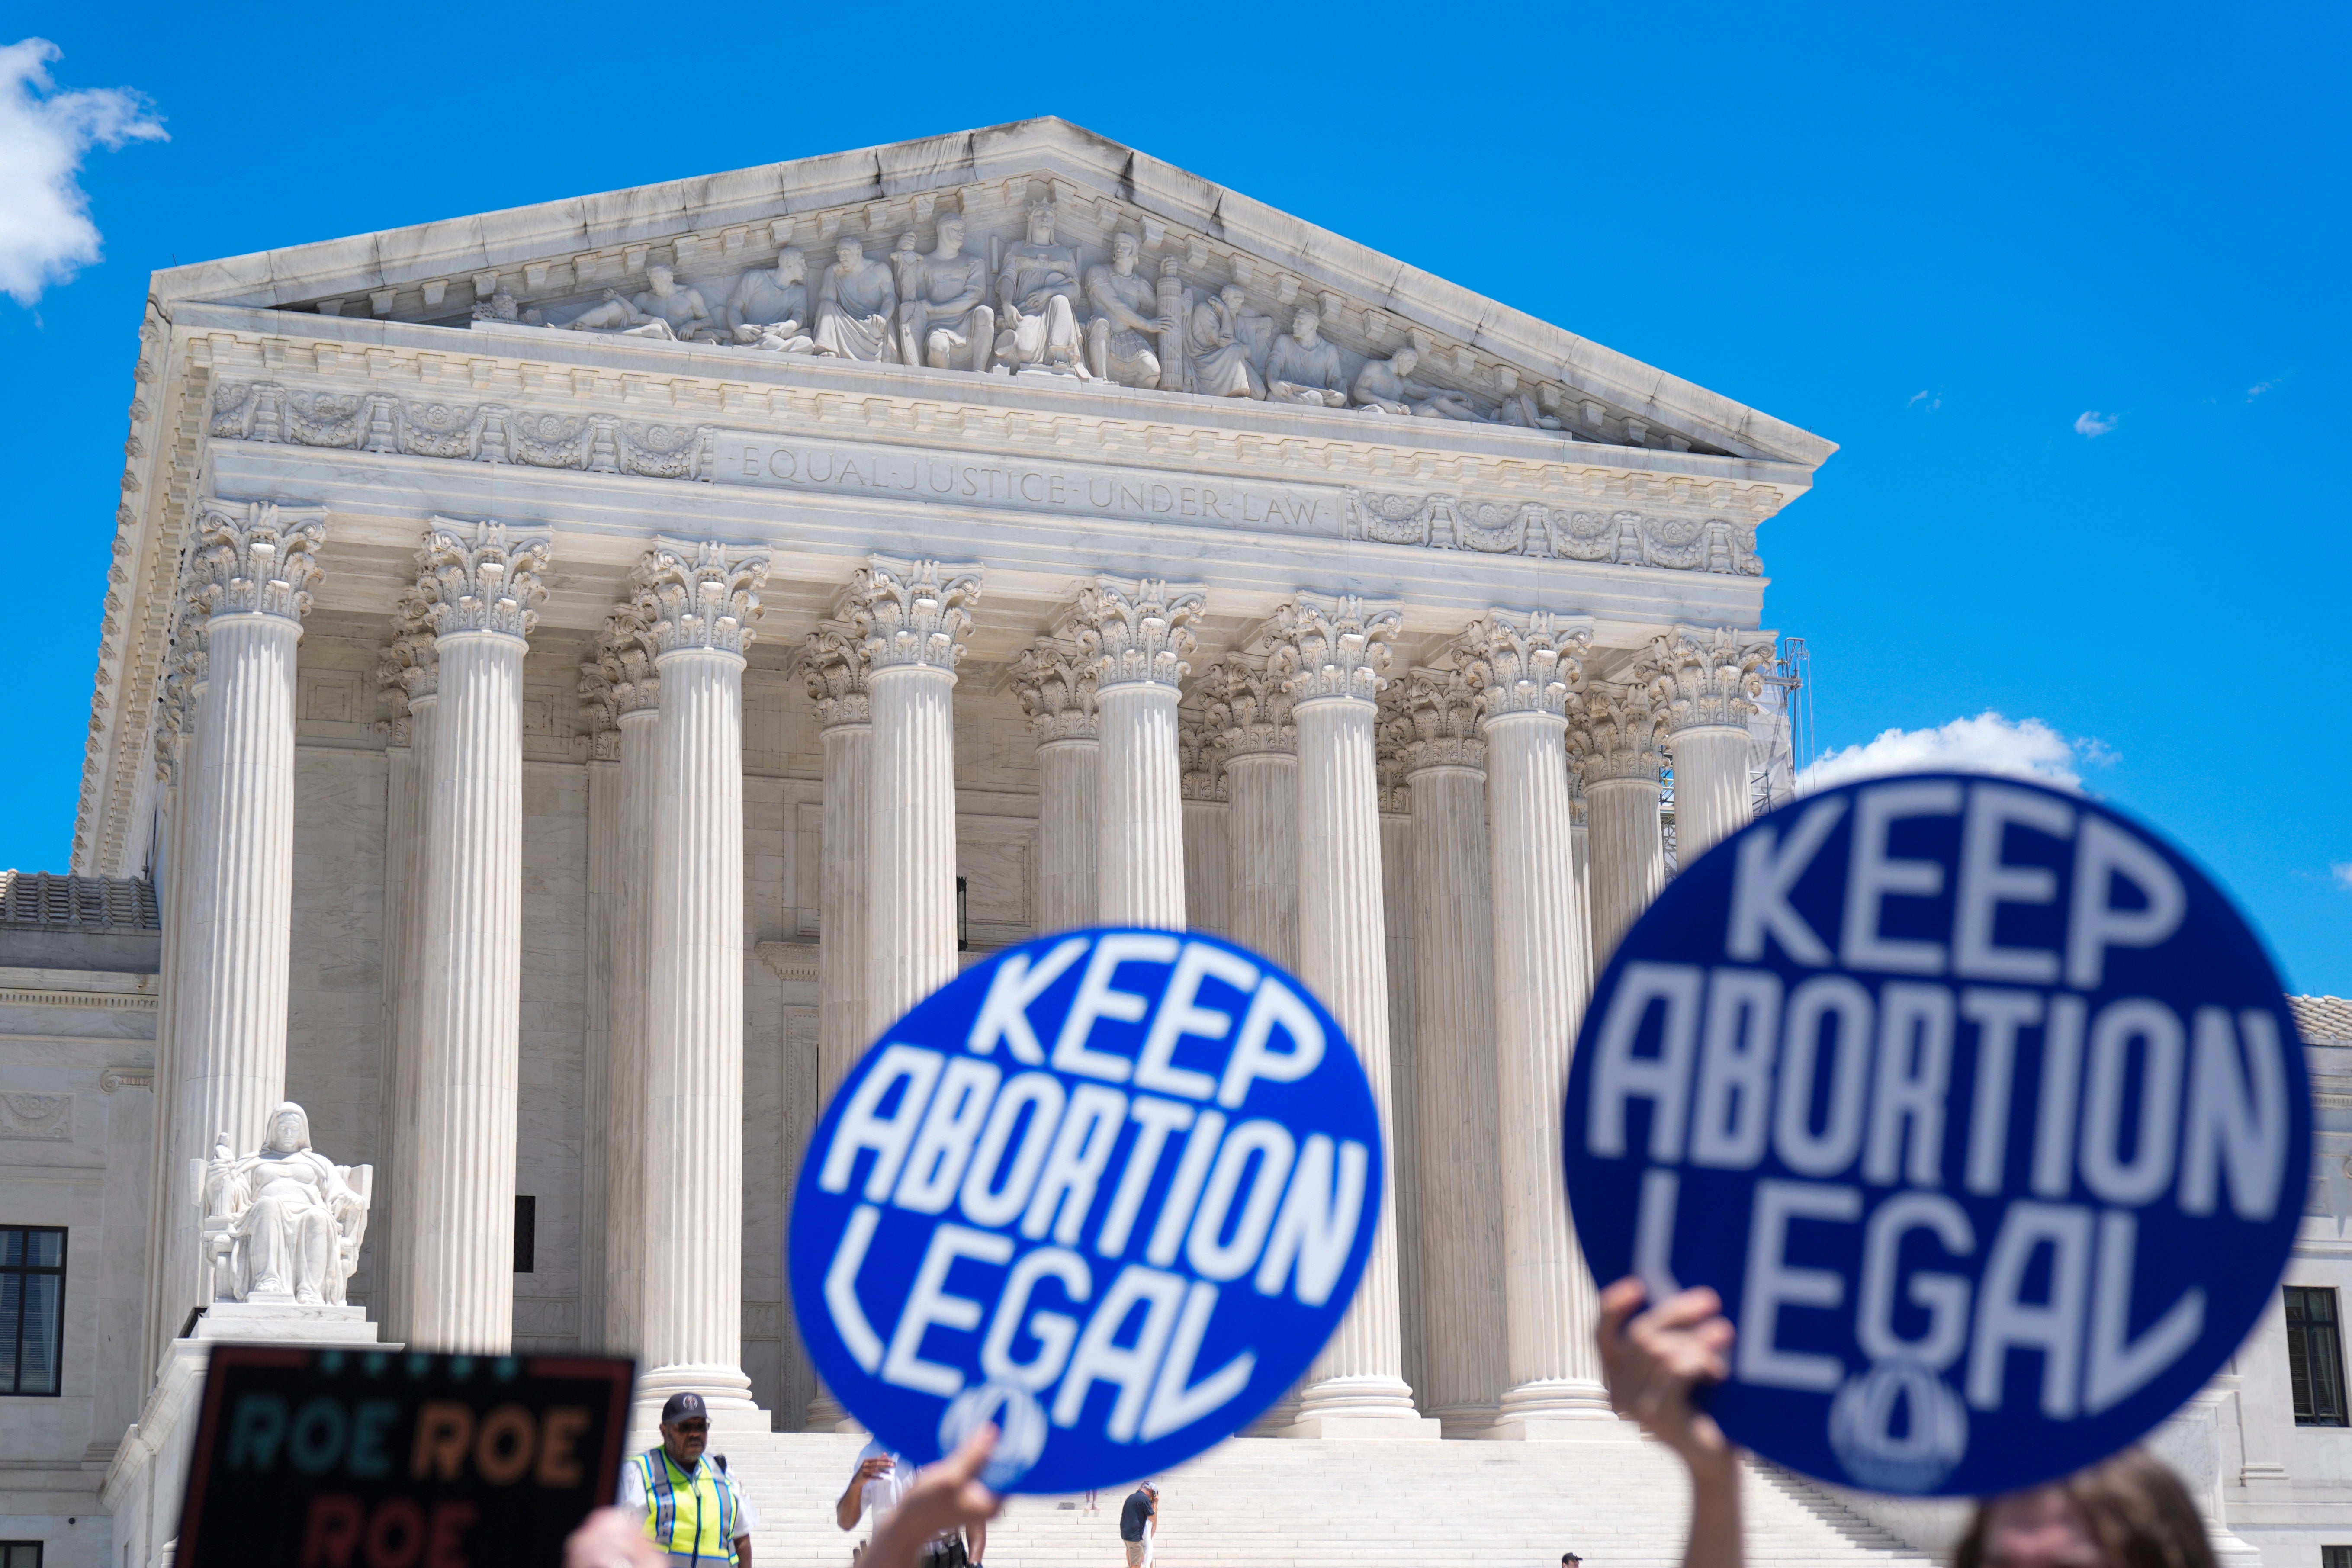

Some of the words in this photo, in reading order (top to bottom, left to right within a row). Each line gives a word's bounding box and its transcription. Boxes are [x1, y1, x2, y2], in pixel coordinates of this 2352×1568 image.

[742, 445, 890, 488] EQUAL
[899, 461, 1066, 504] JUSTICE
[1088, 477, 1229, 519] UNDER
[1242, 491, 1320, 526] LAW
[1726, 781, 2187, 989] KEEP
[966, 932, 1327, 1111] KEEP
[1587, 961, 2288, 1219] ABORTION
[818, 1042, 1369, 1307] ABORTION
[823, 1203, 1258, 1444] LEGAL
[1634, 1170, 2204, 1418] LEGAL
[228, 1394, 400, 1481] ROE
[409, 1400, 593, 1488] ROE
[302, 1492, 479, 1568] ROE
